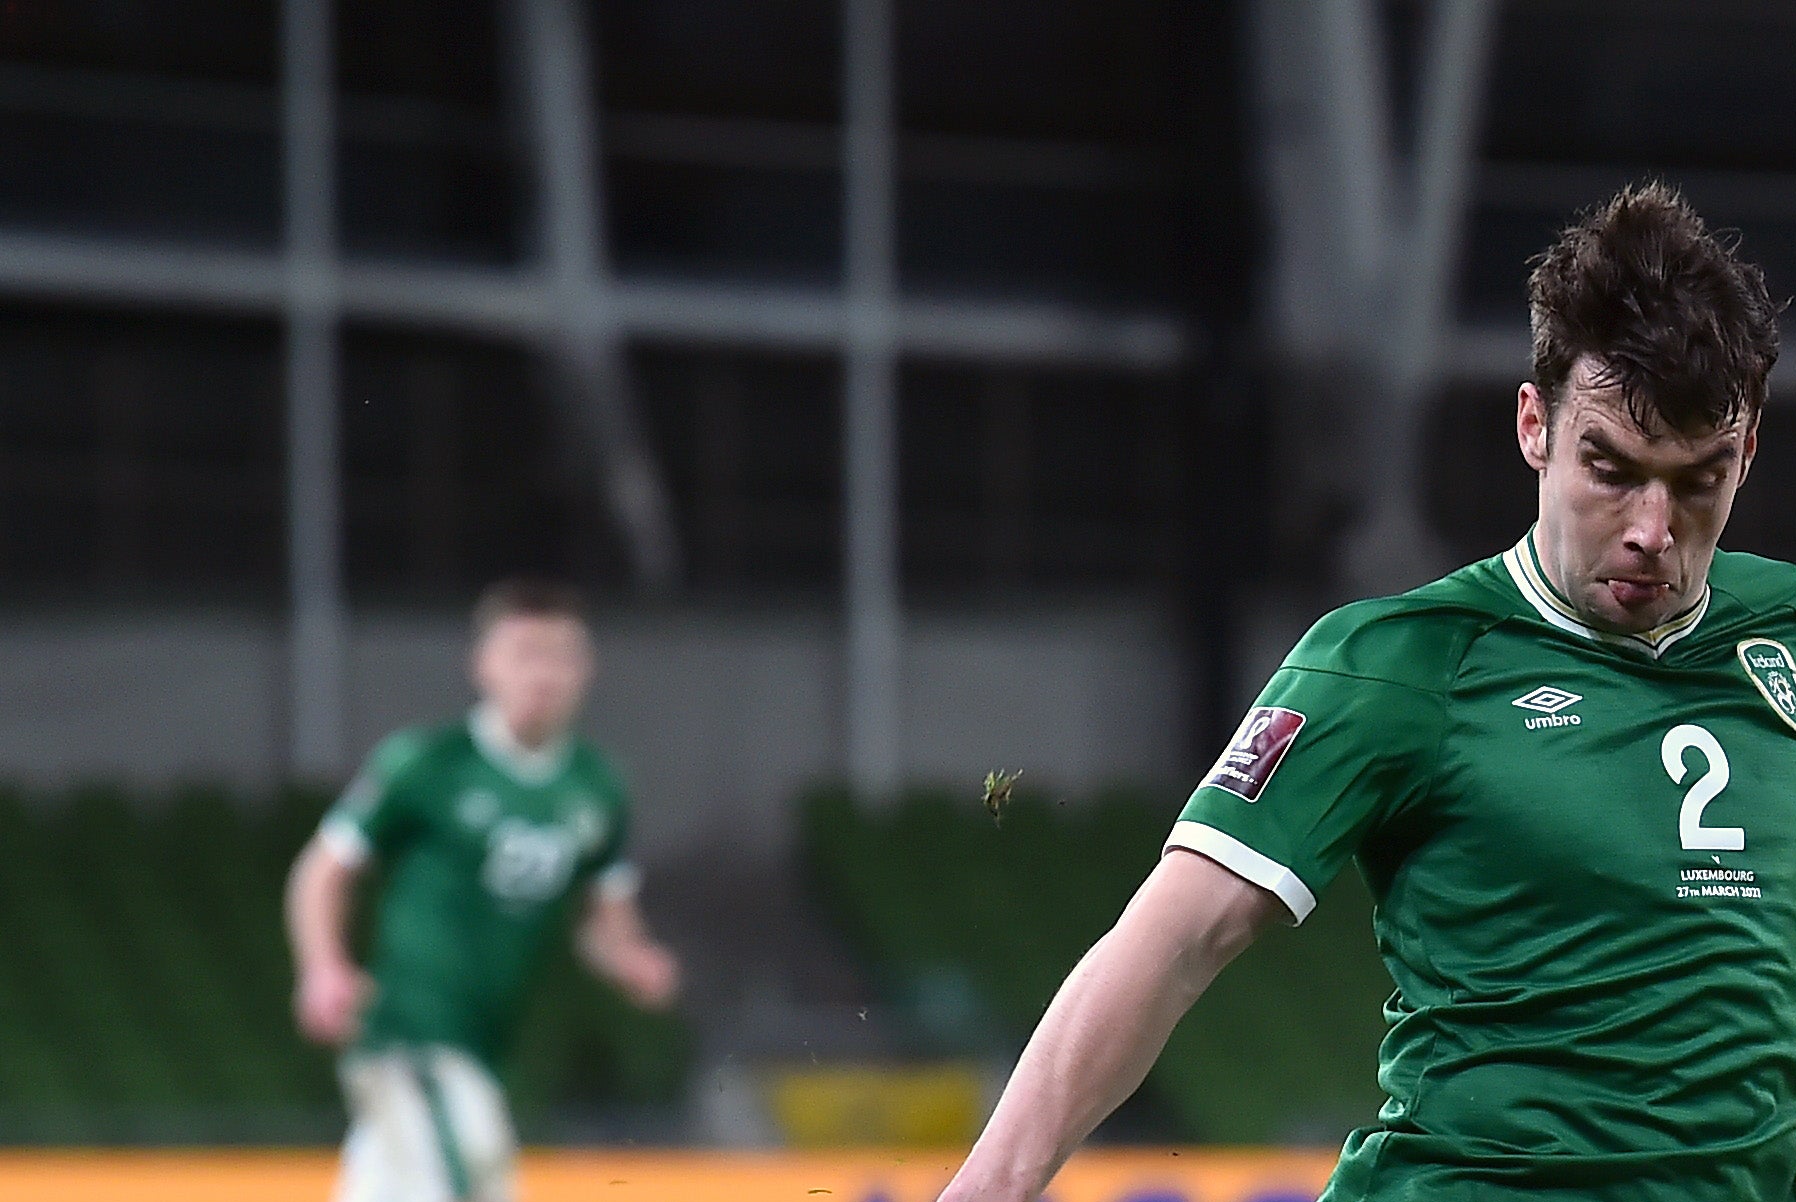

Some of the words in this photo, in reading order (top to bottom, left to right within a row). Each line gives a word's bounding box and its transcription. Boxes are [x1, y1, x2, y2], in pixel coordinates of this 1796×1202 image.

[1524, 713, 1582, 730] umbro
[1661, 724, 1745, 851] 2
[1680, 869, 1755, 882] LUXEMBOURG
[1701, 885, 1740, 897] MARCH
